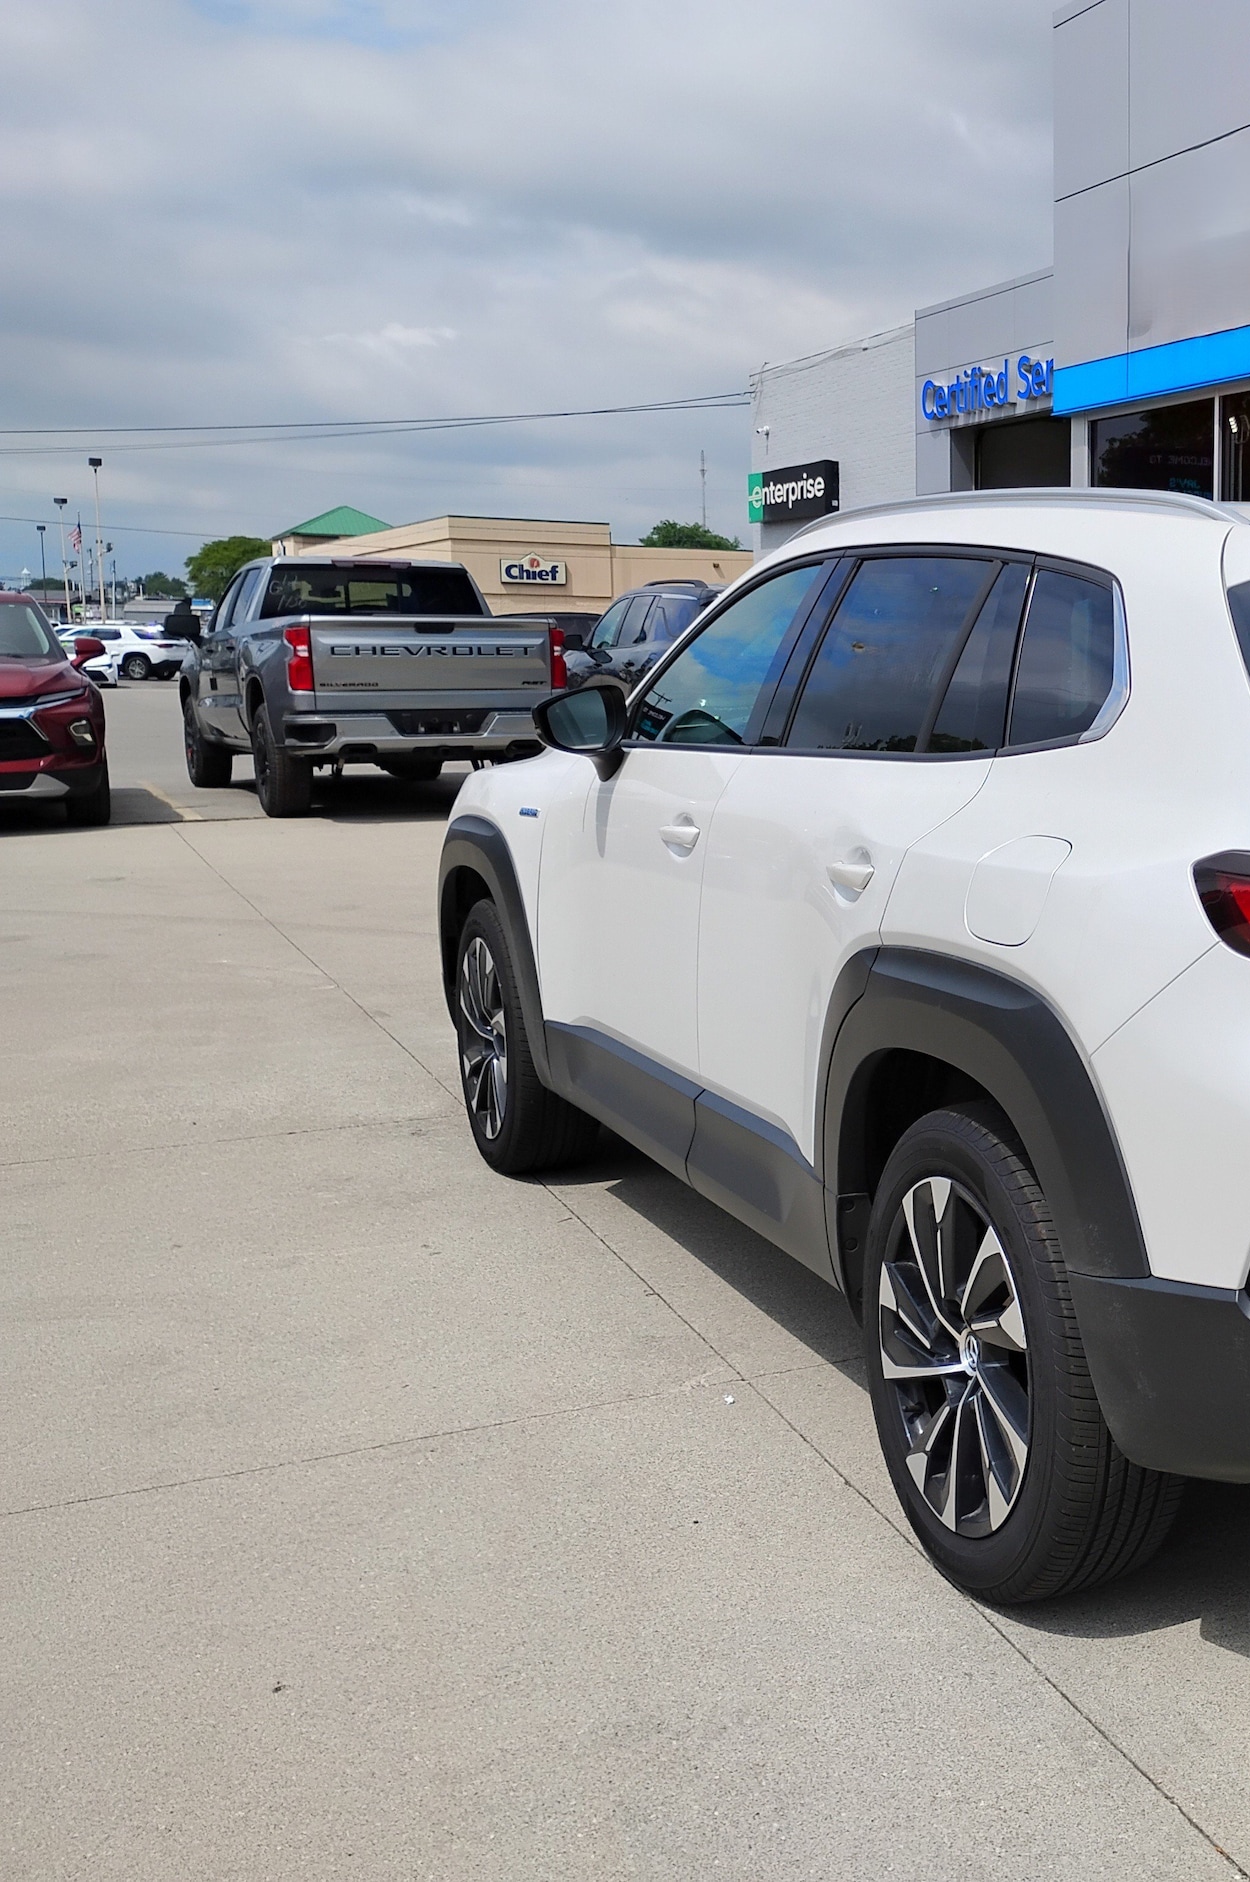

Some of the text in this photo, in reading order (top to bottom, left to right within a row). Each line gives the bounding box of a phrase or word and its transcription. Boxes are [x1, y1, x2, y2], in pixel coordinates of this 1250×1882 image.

[922, 355, 1054, 421] Certified Ser
[748, 472, 825, 509] enterprise
[505, 563, 559, 581] Chief
[330, 645, 537, 657] CHEVROLET
